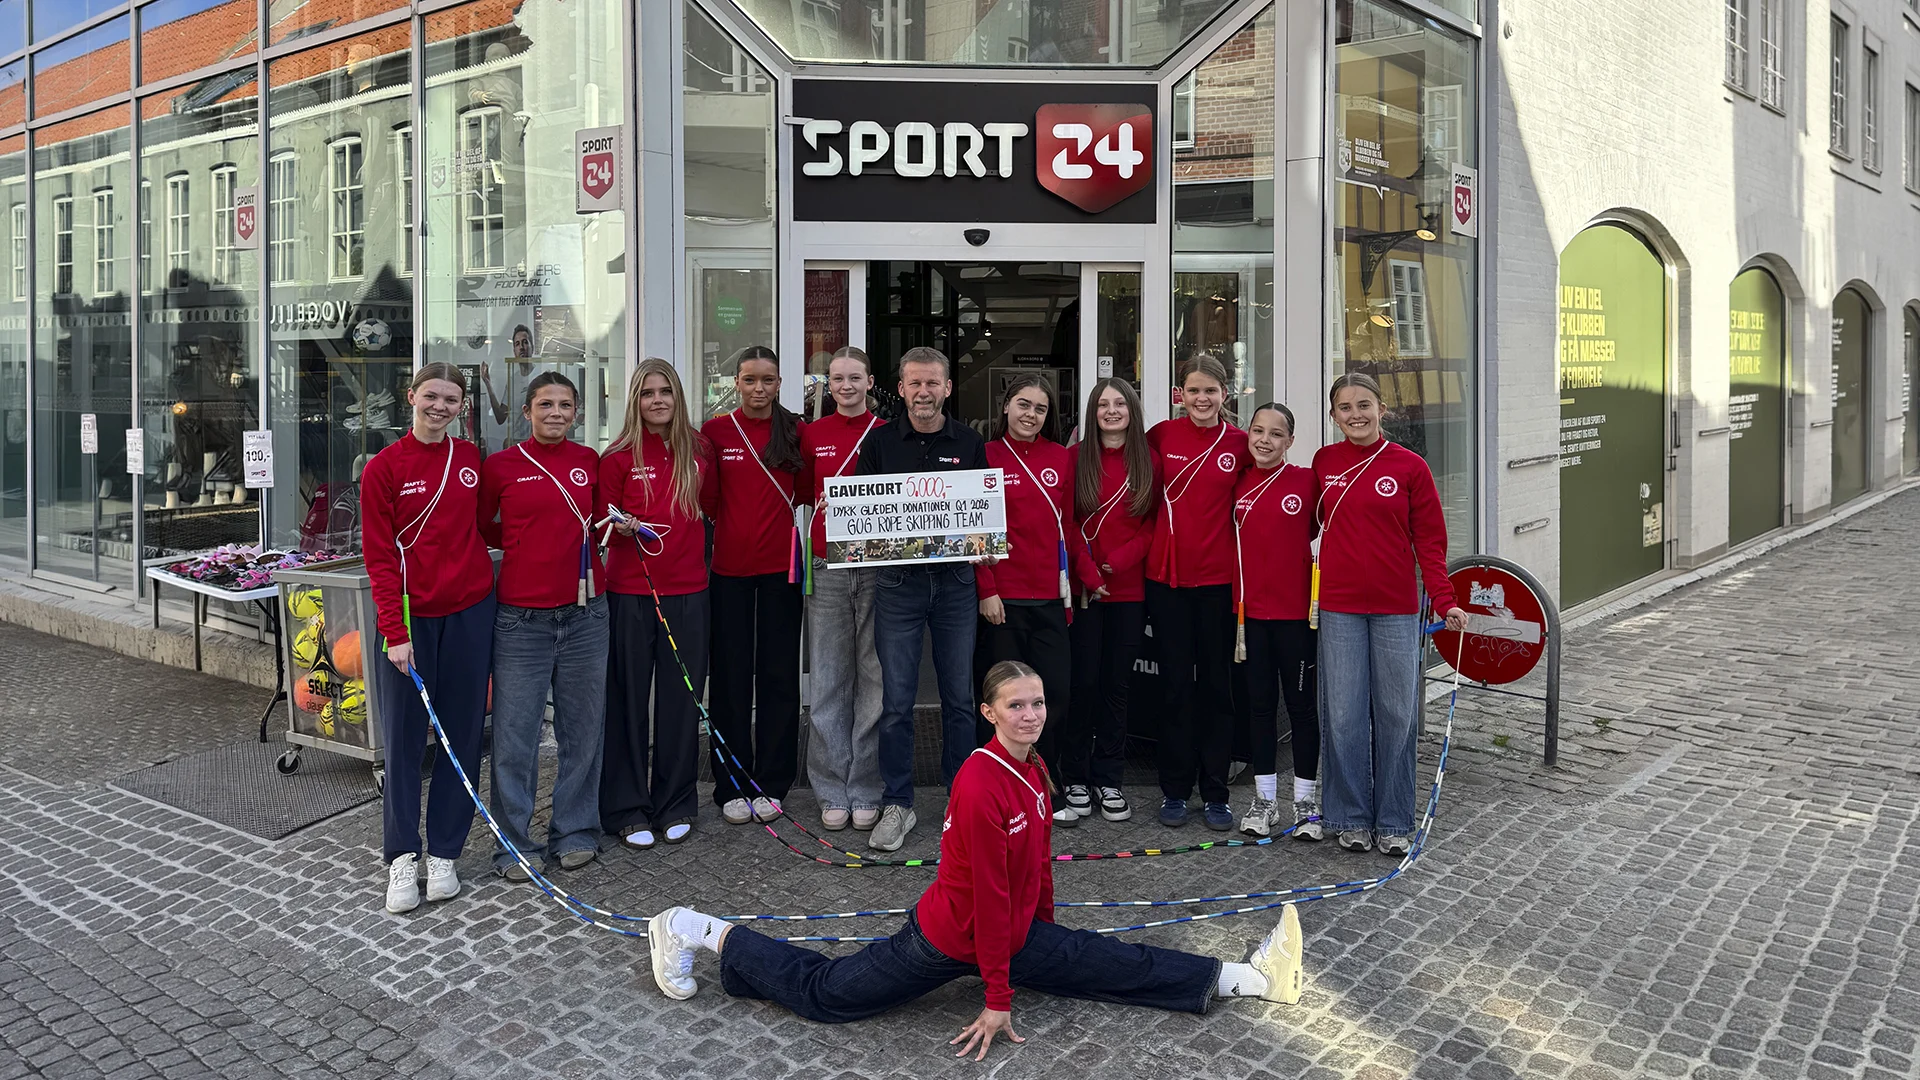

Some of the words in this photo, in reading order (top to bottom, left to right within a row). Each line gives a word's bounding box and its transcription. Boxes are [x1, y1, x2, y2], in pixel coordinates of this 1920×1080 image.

[582, 137, 614, 154] SPORT
[801, 119, 1030, 178] SPORT
[1051, 122, 1144, 180] 24
[586, 160, 612, 186] 24
[1455, 173, 1471, 186] SPORT
[237, 194, 254, 206] SPORT
[1457, 192, 1470, 214] 24
[240, 211, 254, 231] 24
[494, 278, 551, 289] FOOTBALL
[511, 294, 542, 307] PERFORMS
[1575, 286, 1587, 309] EN
[1588, 288, 1603, 310] DEL
[1566, 313, 1605, 336] KLUBBEN
[1568, 334, 1579, 362] FÅ
[1580, 340, 1615, 362] MASSER
[1567, 366, 1602, 389] FORDELE
[246, 450, 270, 463] 100,-
[829, 482, 902, 498] GAVEKORT
[906, 476, 952, 500] 5.000,-
[833, 505, 857, 518] DYRK
[860, 503, 898, 516] GLÆDEN
[902, 501, 950, 513] DONATIONEN
[955, 500, 967, 512] Q1
[970, 499, 989, 510] 2026
[878, 516, 902, 533] ROPE
[906, 513, 950, 531] SKIPPING
[954, 512, 984, 528] TEAM
[308, 679, 343, 699] SELECT
